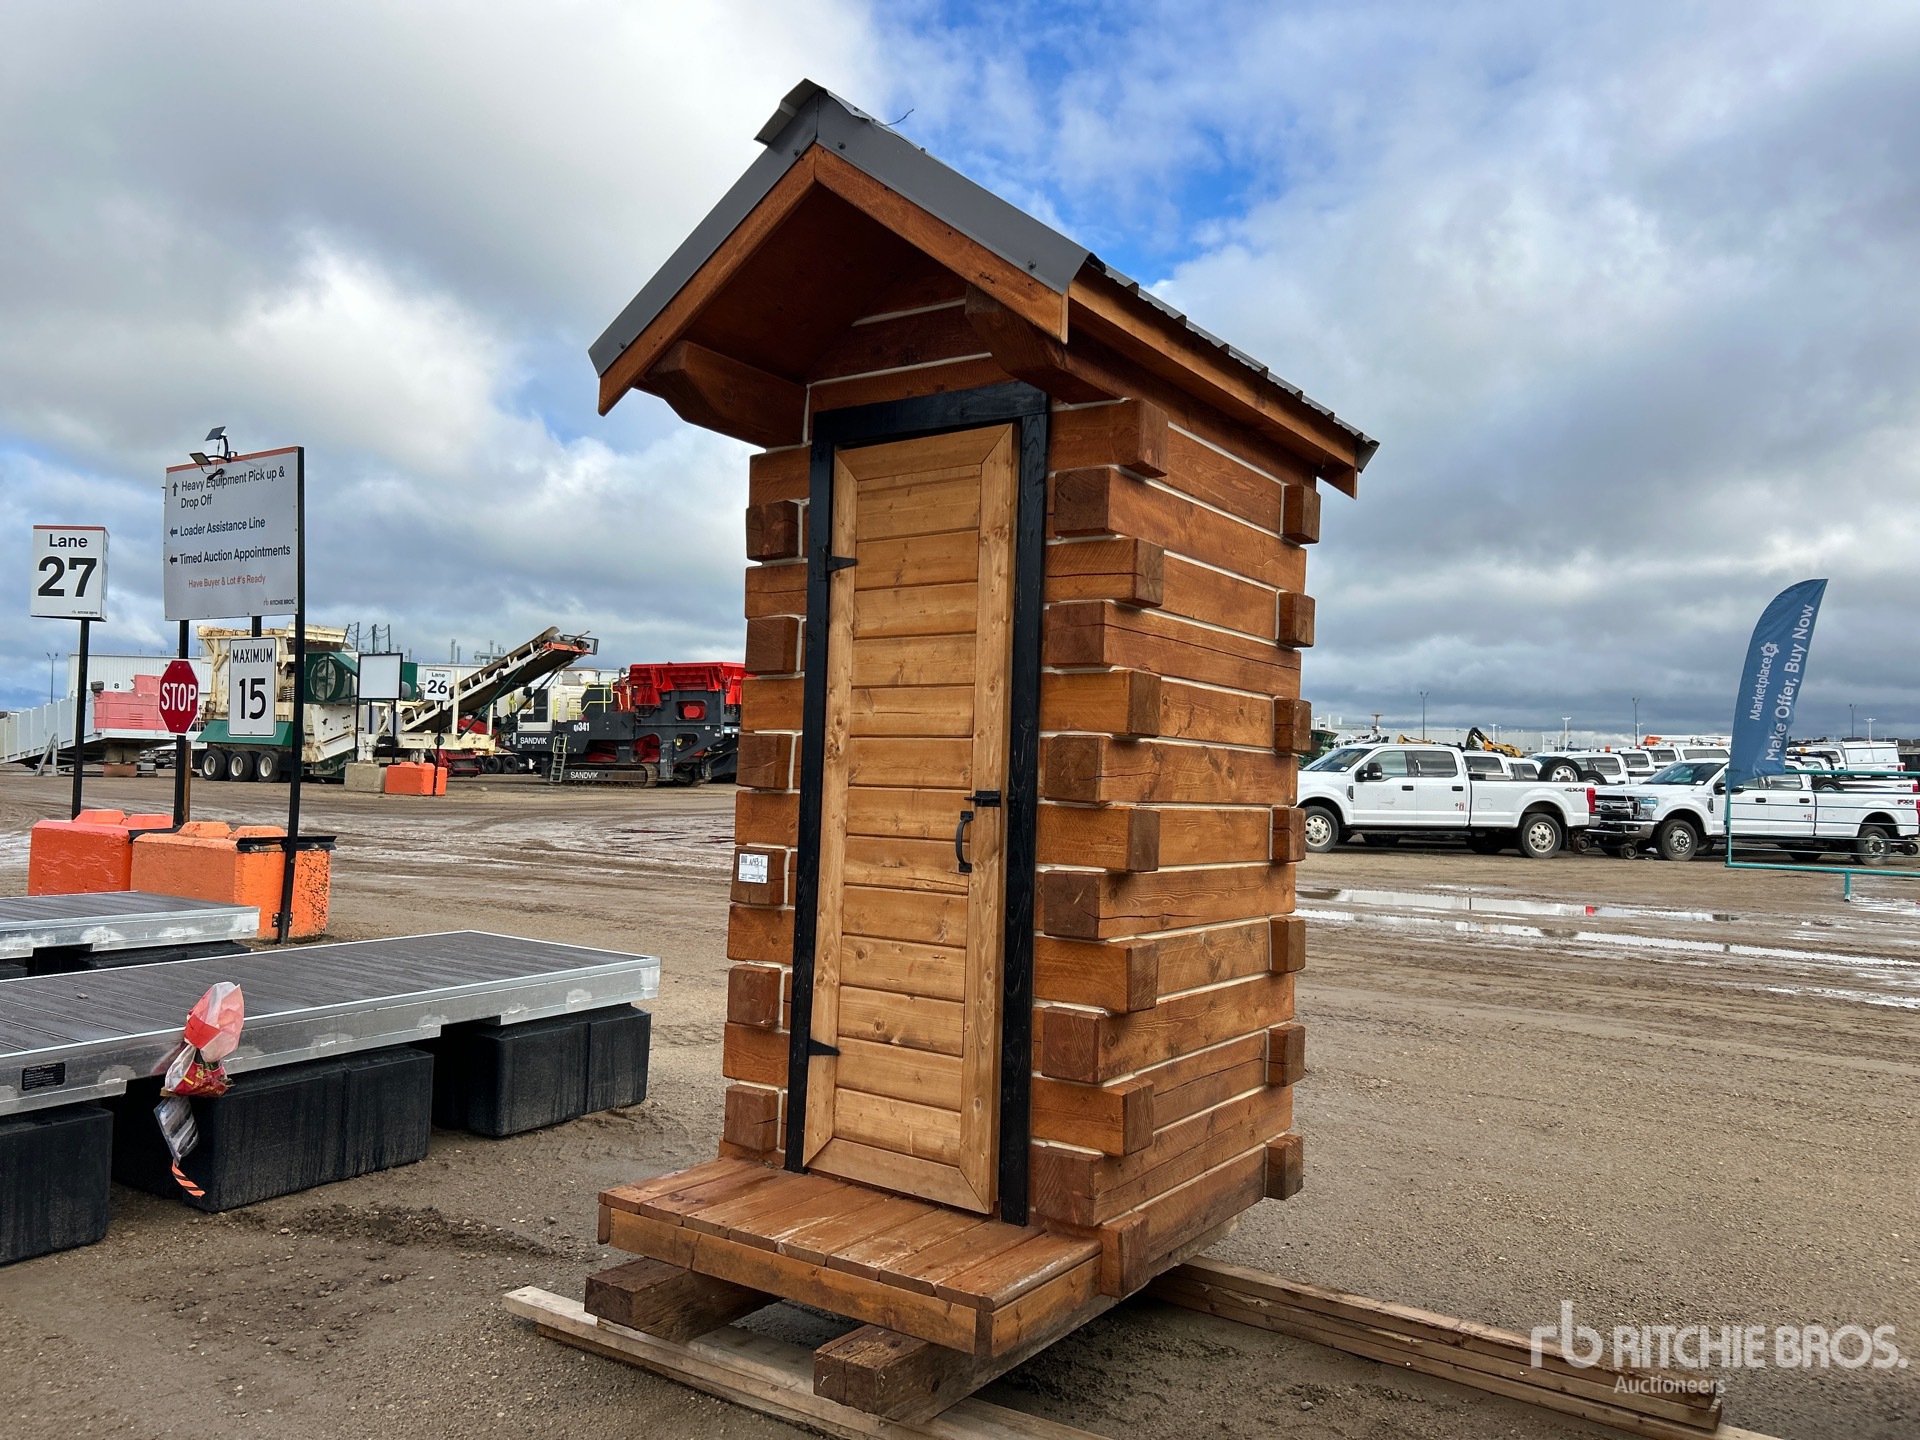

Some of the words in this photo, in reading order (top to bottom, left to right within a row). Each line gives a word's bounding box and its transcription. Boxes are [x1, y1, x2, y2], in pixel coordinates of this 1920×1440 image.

[182, 480, 204, 492] Heavy
[206, 474, 247, 490] Equipment
[248, 468, 265, 482] Pick
[267, 470, 277, 481] up
[278, 466, 285, 477] &
[181, 498, 199, 510] Drop
[200, 494, 212, 506] Off
[180, 524, 205, 536] Loader
[207, 521, 247, 534] Assistance
[249, 517, 266, 529] Line
[49, 534, 88, 548] Lane
[180, 552, 202, 564] Timed
[204, 549, 232, 562] Auction
[234, 545, 291, 562] Appointments
[38, 556, 97, 597] 27
[188, 579, 203, 588] Have
[204, 578, 220, 588] Buyer
[226, 576, 236, 585] Lot
[247, 574, 266, 584] Ready
[1792, 604, 1814, 640] Now
[232, 648, 273, 664] MAXIMUM
[1784, 644, 1807, 674] Buy
[161, 682, 197, 712] STOP
[239, 678, 266, 720] 15
[427, 680, 447, 694] 26
[1750, 655, 1772, 721] Marketplace
[1775, 677, 1800, 719] Offer,
[1765, 724, 1786, 761] Make
